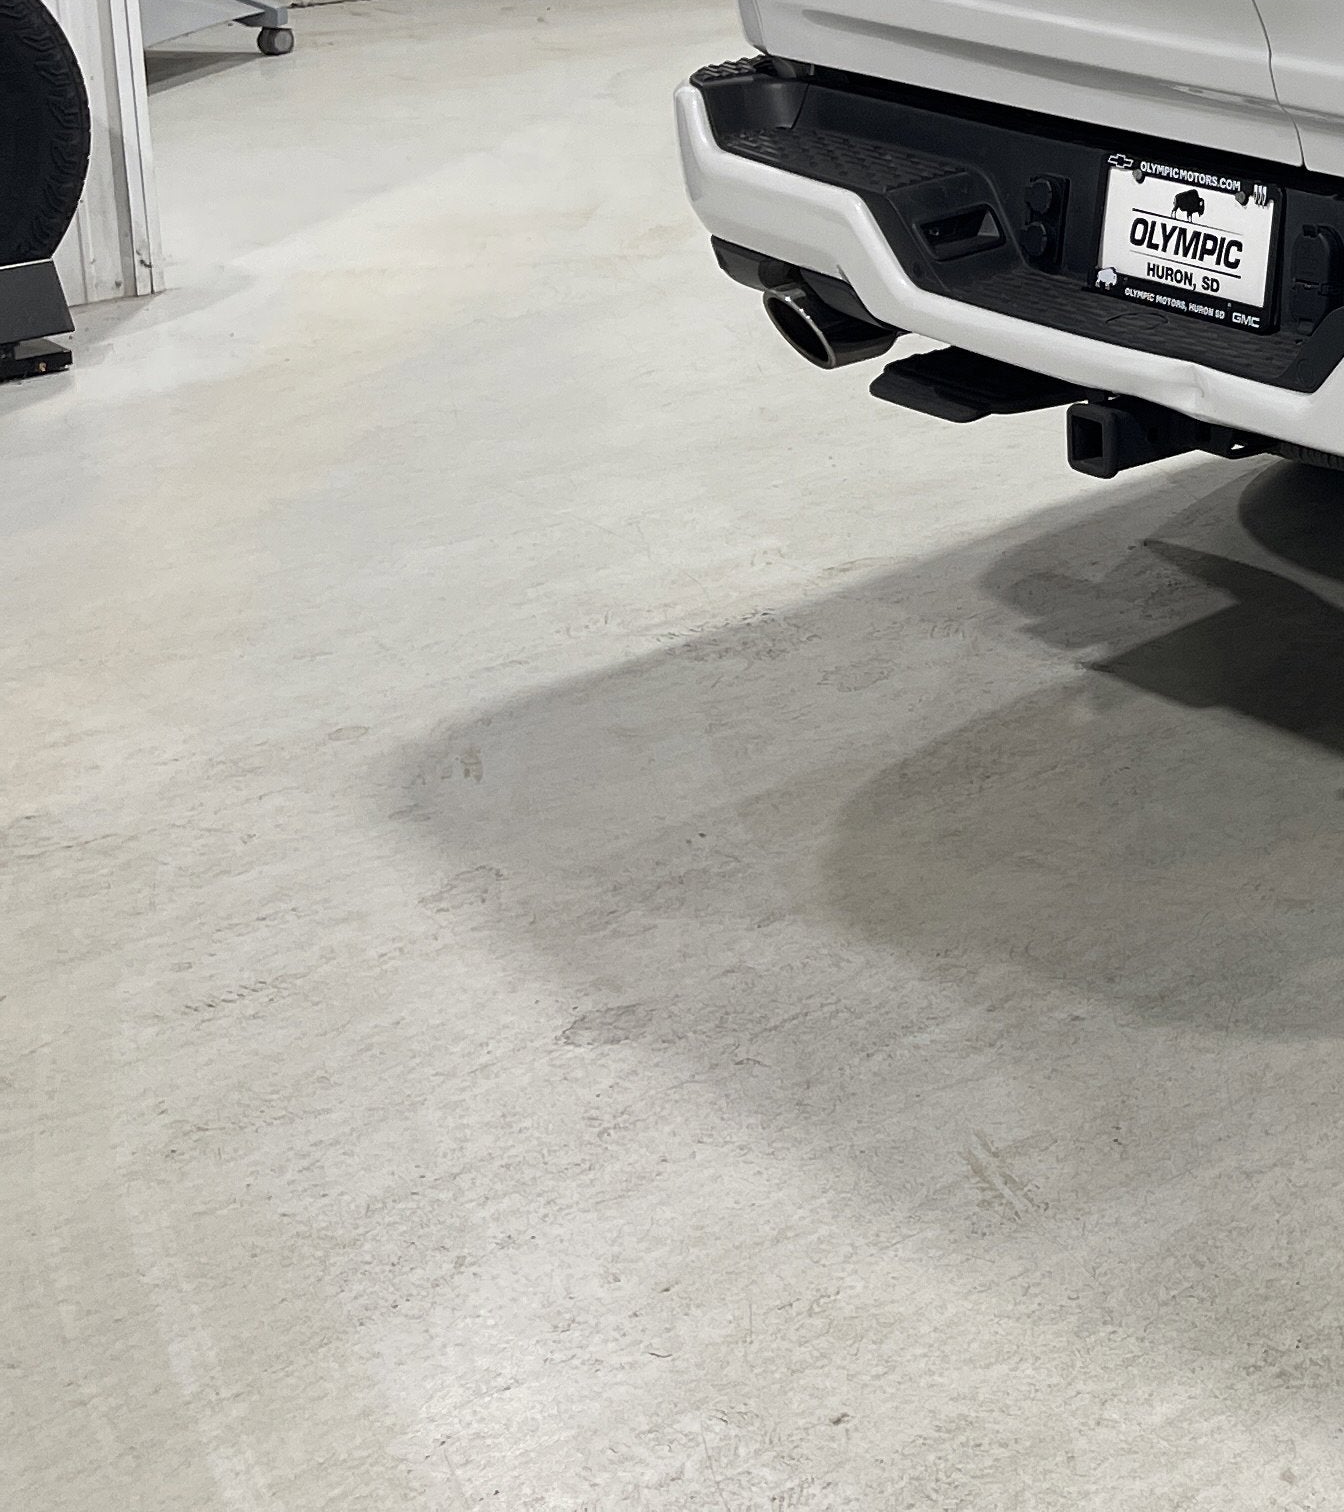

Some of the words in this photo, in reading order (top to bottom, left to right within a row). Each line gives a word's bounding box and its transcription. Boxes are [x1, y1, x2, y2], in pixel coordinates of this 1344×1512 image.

[1140, 161, 1241, 192] OLYMPICMOTORS.COM
[1129, 217, 1243, 270] OLYMPIC
[1146, 262, 1197, 291] HURON,
[1201, 276, 1220, 293] SD
[1124, 288, 1155, 302] OLYMPIC
[1155, 295, 1187, 312] MOTORS,
[1188, 302, 1214, 317] HURON
[1215, 308, 1226, 320] SD
[1232, 312, 1260, 328] GMC
